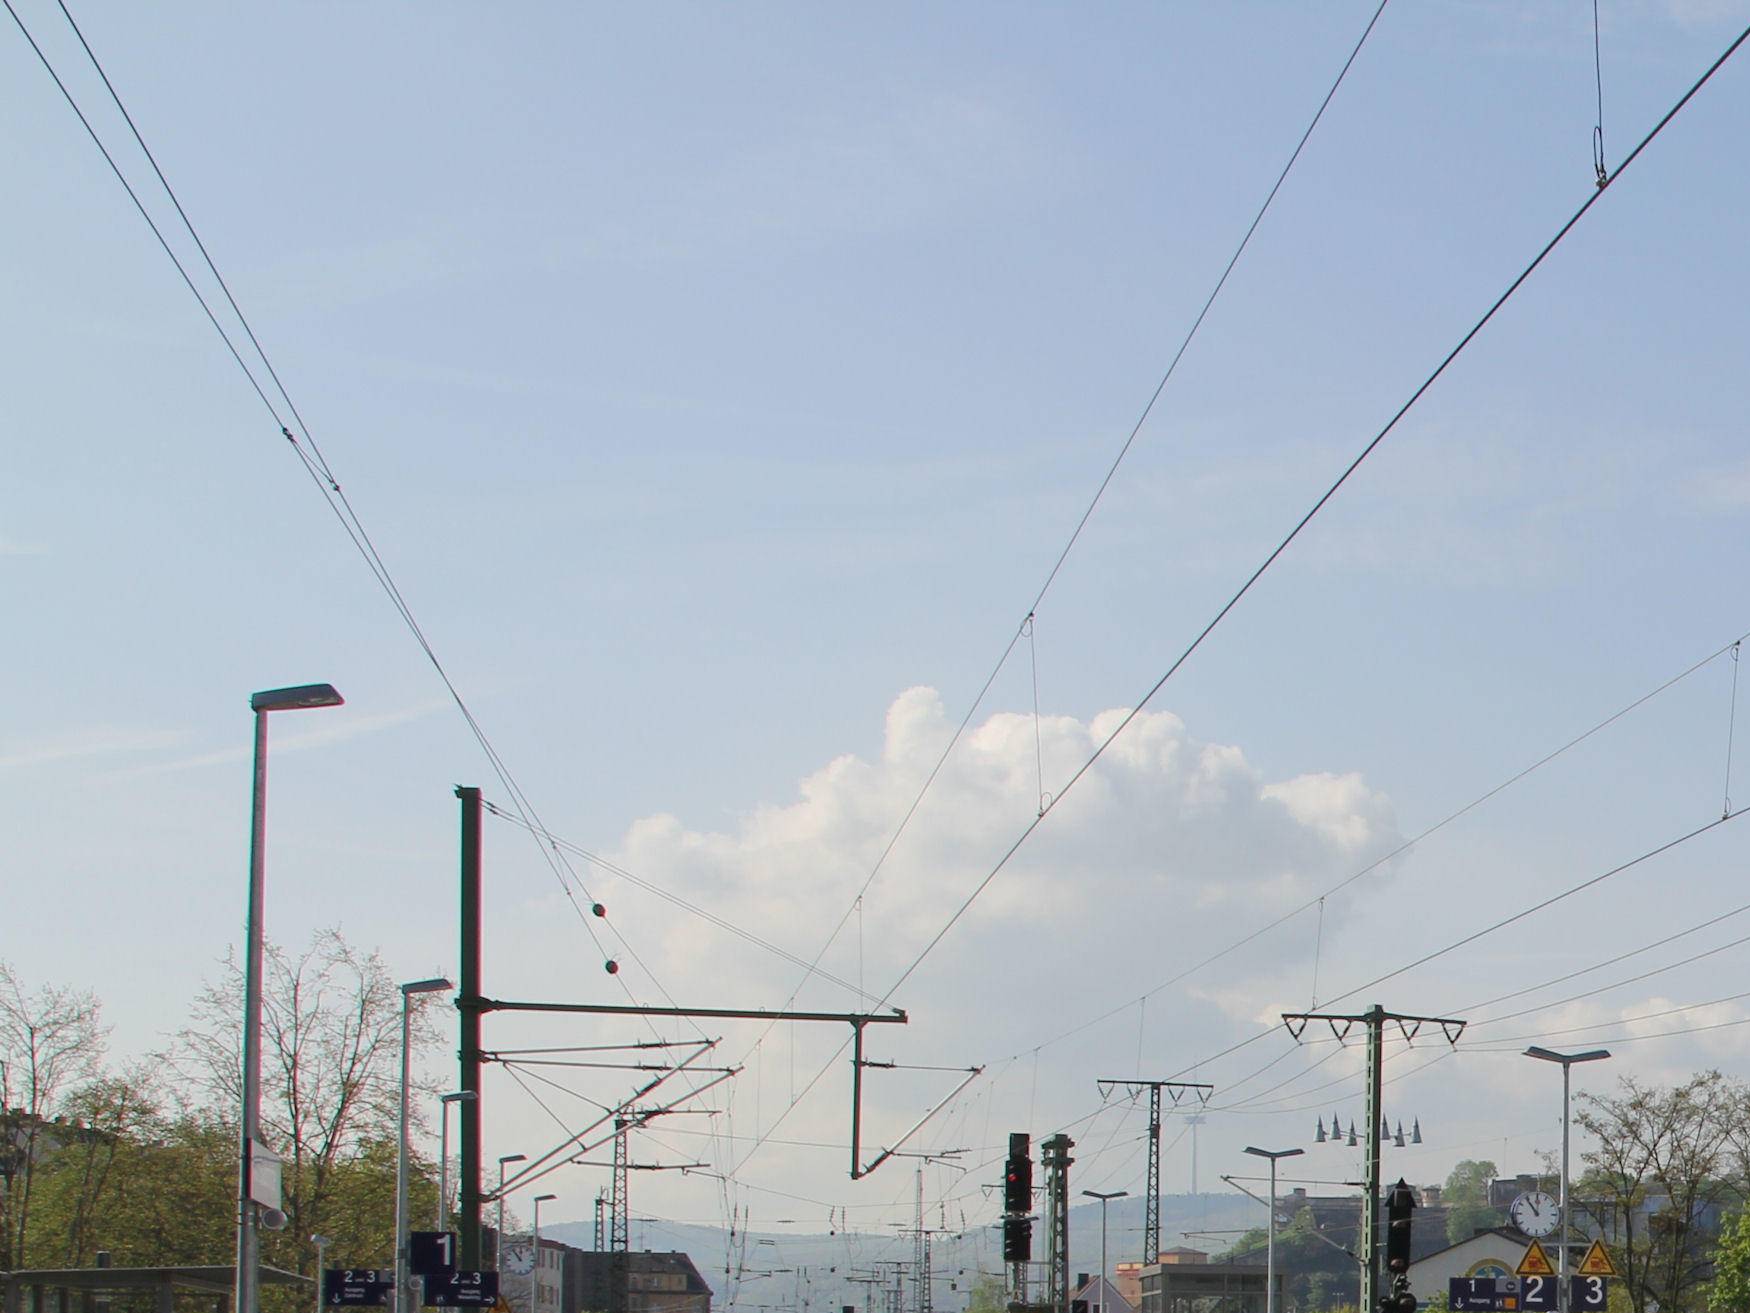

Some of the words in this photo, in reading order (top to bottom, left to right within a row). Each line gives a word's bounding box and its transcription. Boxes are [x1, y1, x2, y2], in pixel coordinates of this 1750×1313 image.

[436, 1234, 451, 1266] 1
[344, 1270, 353, 1283] 2
[366, 1270, 376, 1283] 3
[450, 1272, 460, 1284] 2
[472, 1272, 481, 1285] 3
[1468, 1279, 1475, 1292] 1
[1525, 1276, 1544, 1303] 2
[1585, 1276, 1603, 1304] 3
